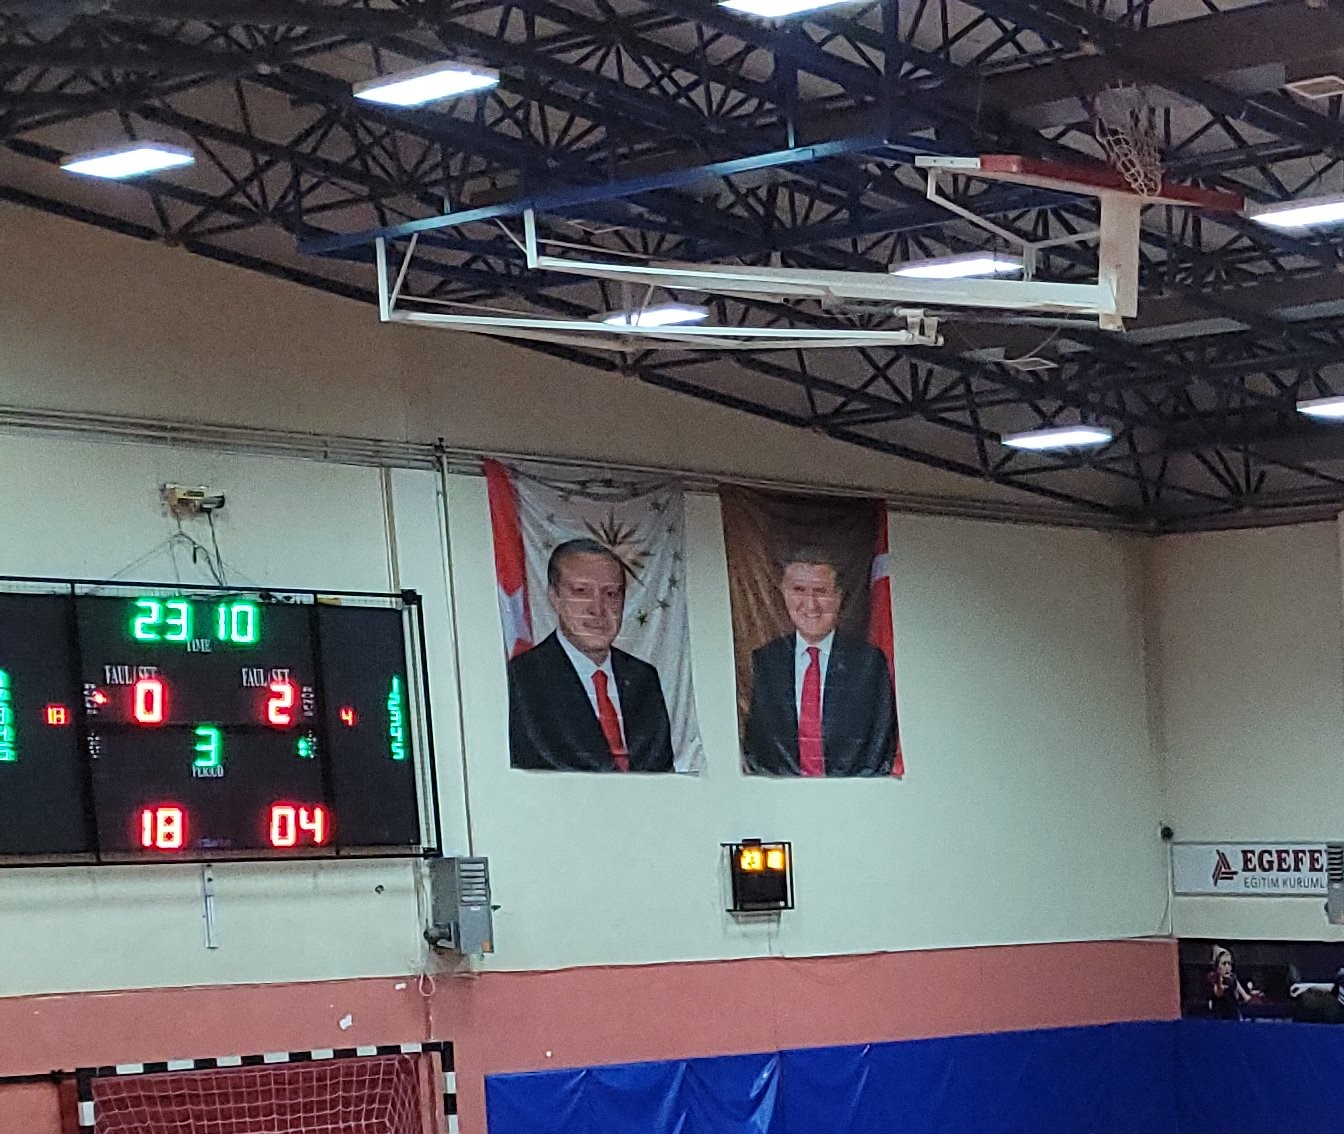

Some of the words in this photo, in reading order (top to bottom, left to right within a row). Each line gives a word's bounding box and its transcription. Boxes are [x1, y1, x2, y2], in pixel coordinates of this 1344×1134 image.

[134, 679, 163, 723] 0
[267, 683, 293, 725] 2
[194, 728, 219, 767] 3
[141, 807, 183, 849] 18
[270, 804, 324, 848] 04
